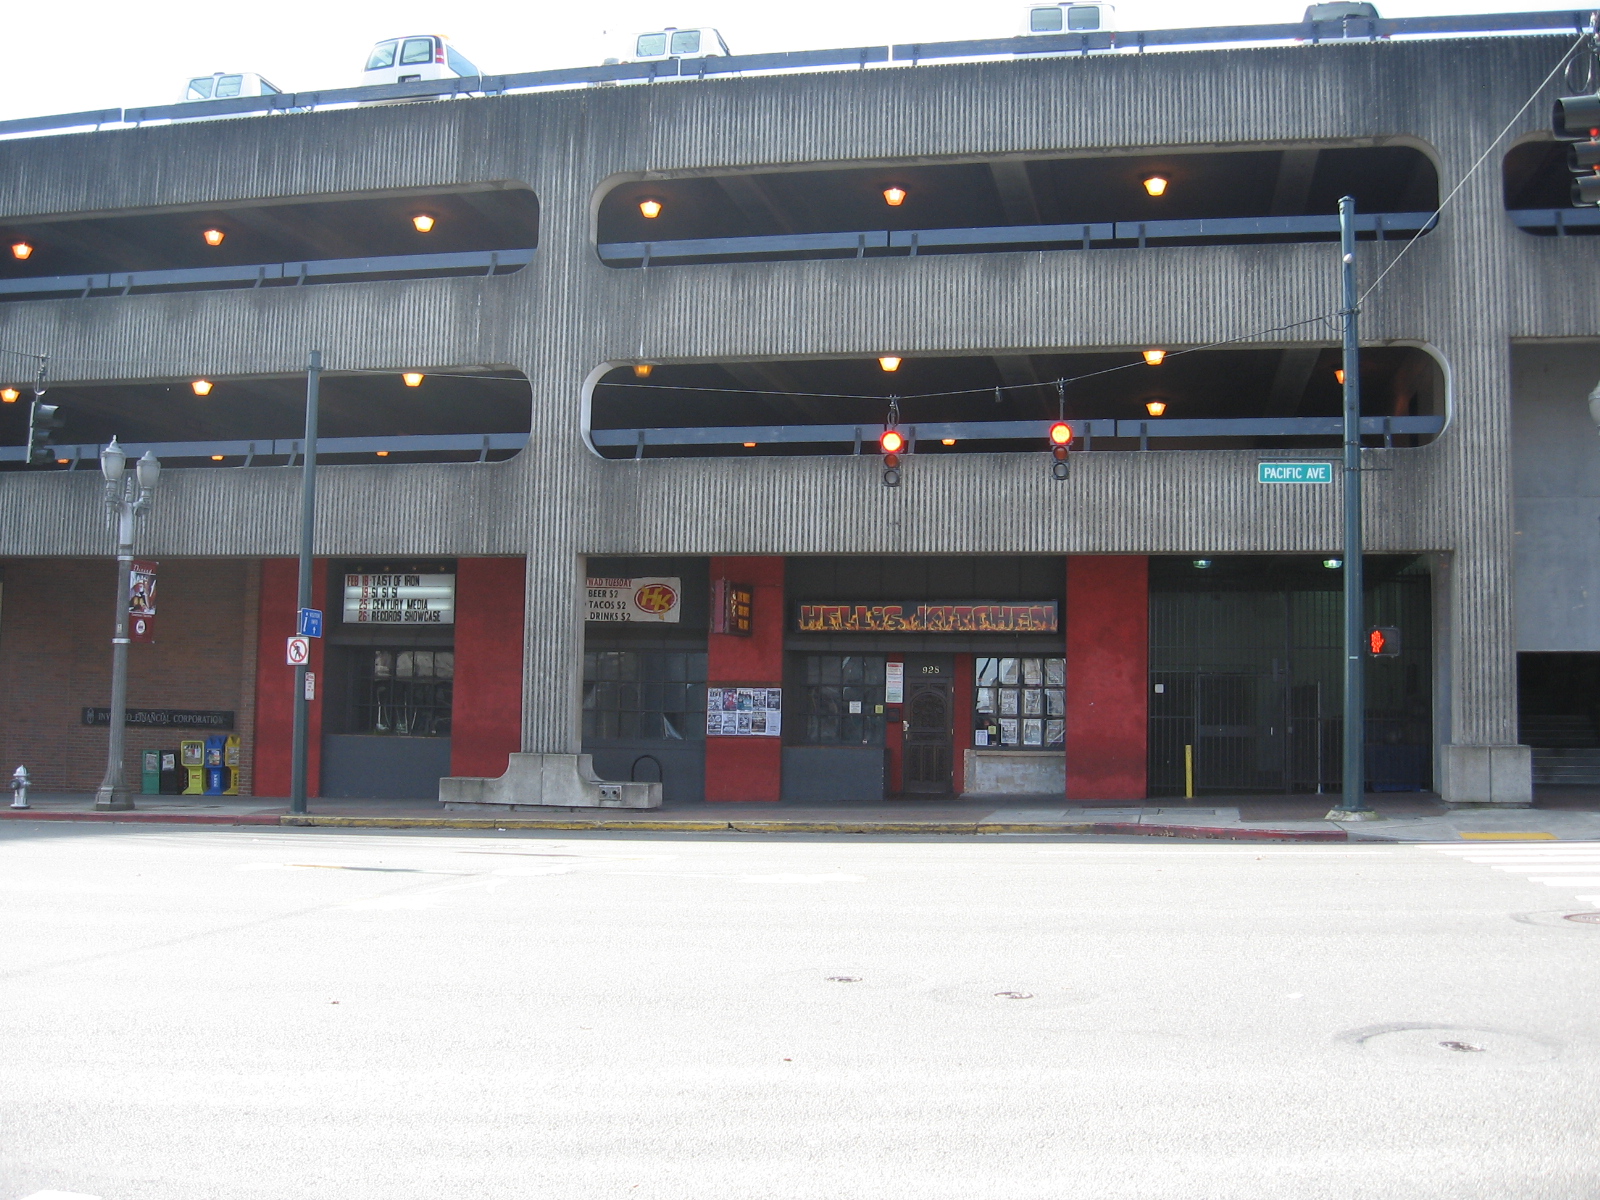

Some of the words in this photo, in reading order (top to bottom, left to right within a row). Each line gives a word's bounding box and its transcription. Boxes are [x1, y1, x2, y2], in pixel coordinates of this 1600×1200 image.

[1264, 467, 1302, 479] PACIFIC
[1306, 467, 1325, 479] AVE
[347, 575, 359, 586] FEB
[393, 575, 402, 586] OF
[404, 575, 420, 586] IRON
[605, 578, 632, 587] TUESDAY
[588, 589, 606, 598] BEER
[609, 589, 618, 598] $2
[372, 599, 403, 610] CENTURY
[407, 599, 428, 610] MEDIA
[589, 600, 615, 609] TACOS
[617, 601, 626, 610] $2
[641, 584, 672, 616] HK
[372, 610, 402, 622] RECORDS
[405, 610, 441, 622] SHOWCASE
[590, 612, 618, 621] DRINKS
[621, 612, 631, 621] $2
[799, 604, 903, 631] HELL'S
[916, 604, 1057, 631] KITCHEN
[135, 712, 171, 723] FINANCIAL
[173, 714, 224, 725] CORPORATION
